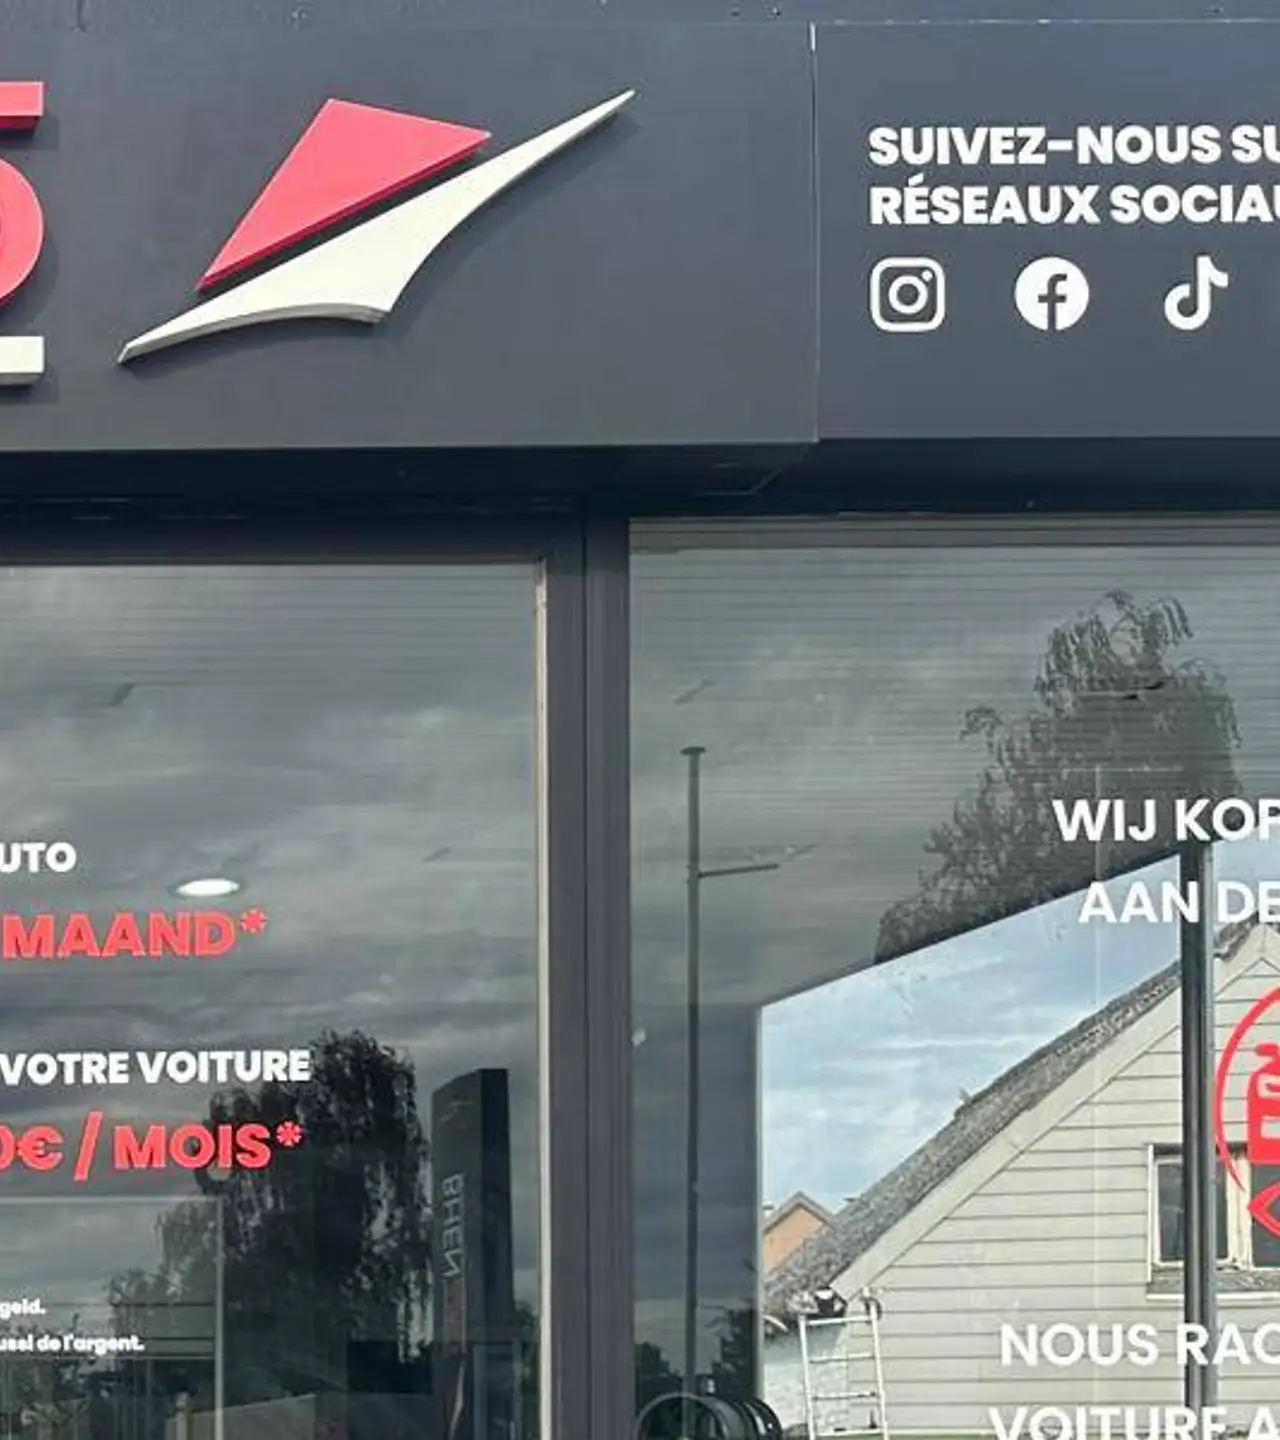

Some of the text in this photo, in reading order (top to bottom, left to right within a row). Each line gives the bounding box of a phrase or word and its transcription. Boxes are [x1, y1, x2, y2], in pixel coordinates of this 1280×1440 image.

[869, 125, 1222, 165] SUIVEZ-NOUS
[871, 172, 1101, 224] RÉSEAUX
[1052, 799, 1156, 841] WIJ
[1078, 880, 1280, 924] AAN DE
[136, 1050, 310, 1084] VOITURE
[73, 1111, 103, 1181] /
[37, 1335, 61, 1352] de
[1001, 1322, 1159, 1366] NOUS
